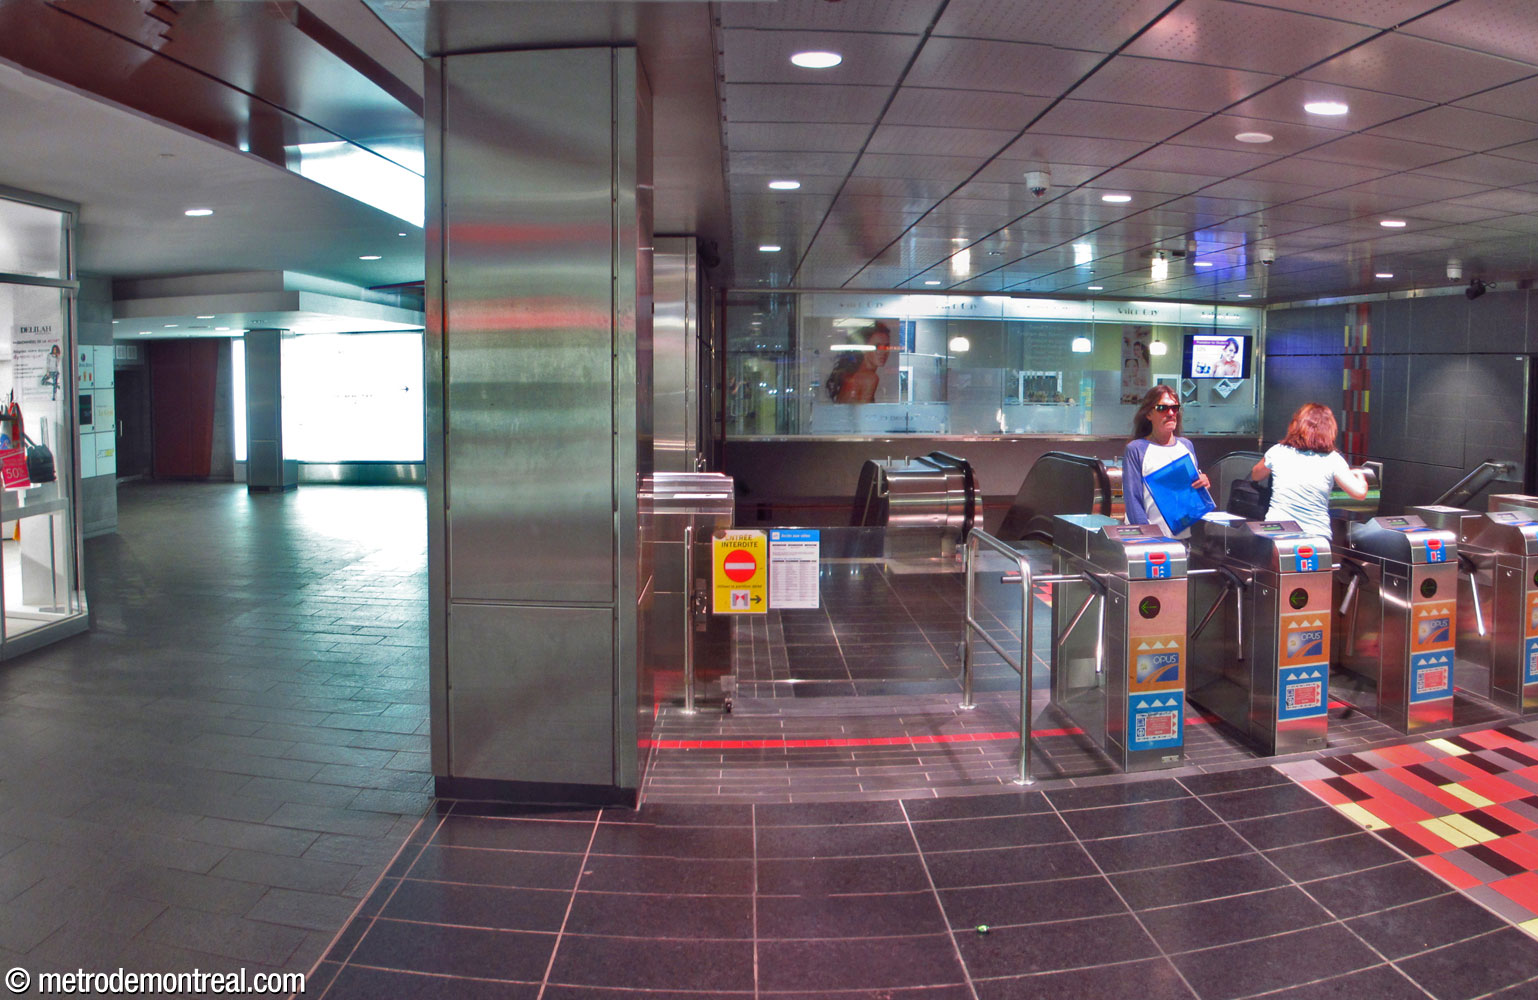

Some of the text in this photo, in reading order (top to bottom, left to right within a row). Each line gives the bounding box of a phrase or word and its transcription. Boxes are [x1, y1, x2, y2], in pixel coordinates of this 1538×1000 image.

[1430, 619, 1448, 629] OPUS
[1301, 632, 1321, 641] OPUS
[1152, 655, 1177, 665] OPUS
